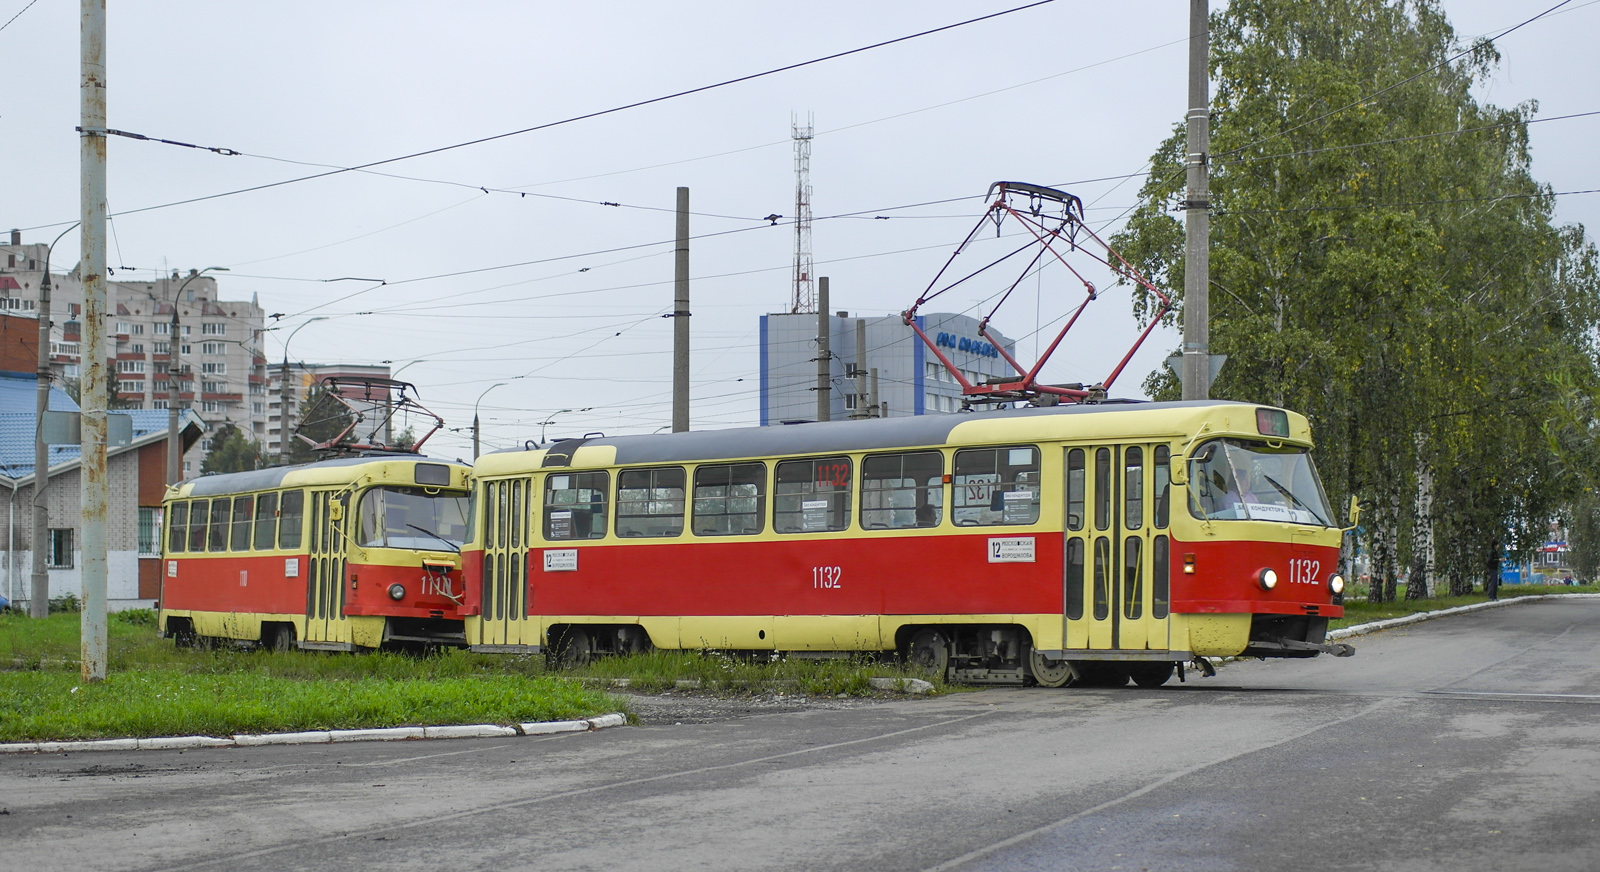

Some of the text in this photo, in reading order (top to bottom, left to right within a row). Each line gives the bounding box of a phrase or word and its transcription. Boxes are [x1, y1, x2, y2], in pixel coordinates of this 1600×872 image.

[817, 464, 849, 487] 1132
[546, 553, 552, 567] 12
[992, 541, 1001, 558] 12
[812, 566, 842, 589] 1132
[1289, 558, 1320, 585] 1132
